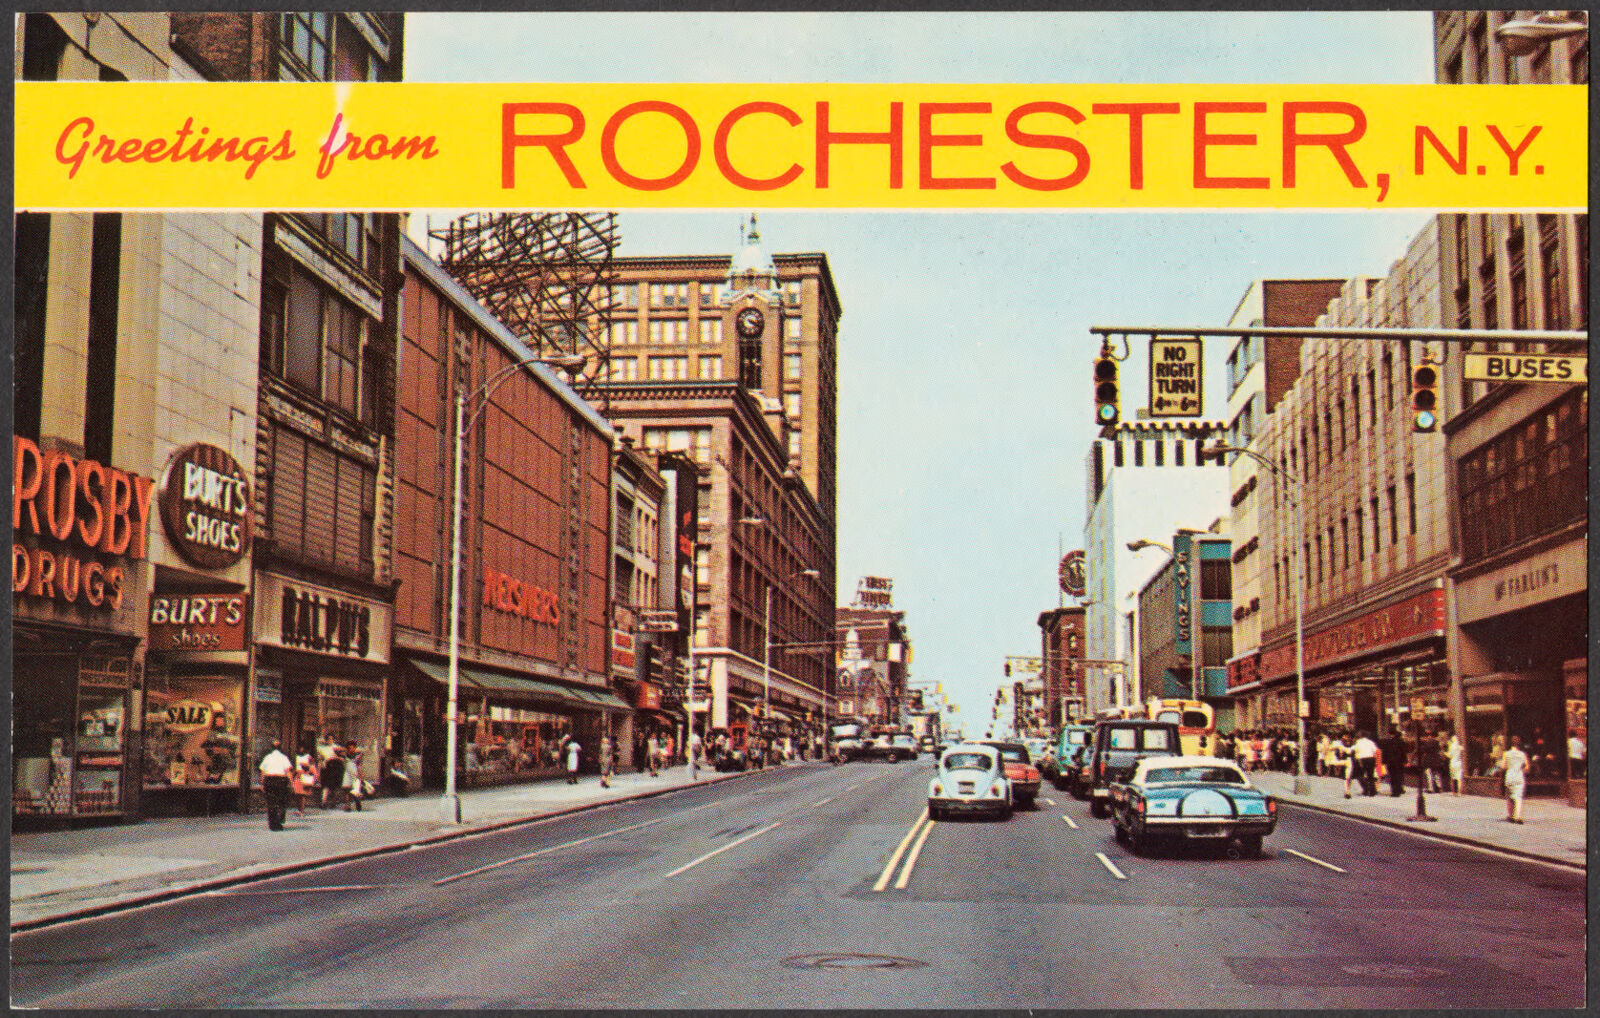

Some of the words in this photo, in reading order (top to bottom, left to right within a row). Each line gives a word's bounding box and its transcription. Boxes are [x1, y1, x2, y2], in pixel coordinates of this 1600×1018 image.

[1163, 346, 1186, 361] NO
[1156, 363, 1195, 378] RIGHT
[1487, 357, 1572, 379] BUSES
[1156, 379, 1196, 394] TURN
[13, 434, 156, 559] ROSBY
[184, 461, 247, 516] BURT'S
[185, 511, 240, 552] SHOES
[12, 544, 124, 610] DRUGS
[1178, 551, 1190, 641] SAVINGS
[172, 627, 221, 647] shoes
[166, 706, 208, 725] SALE
